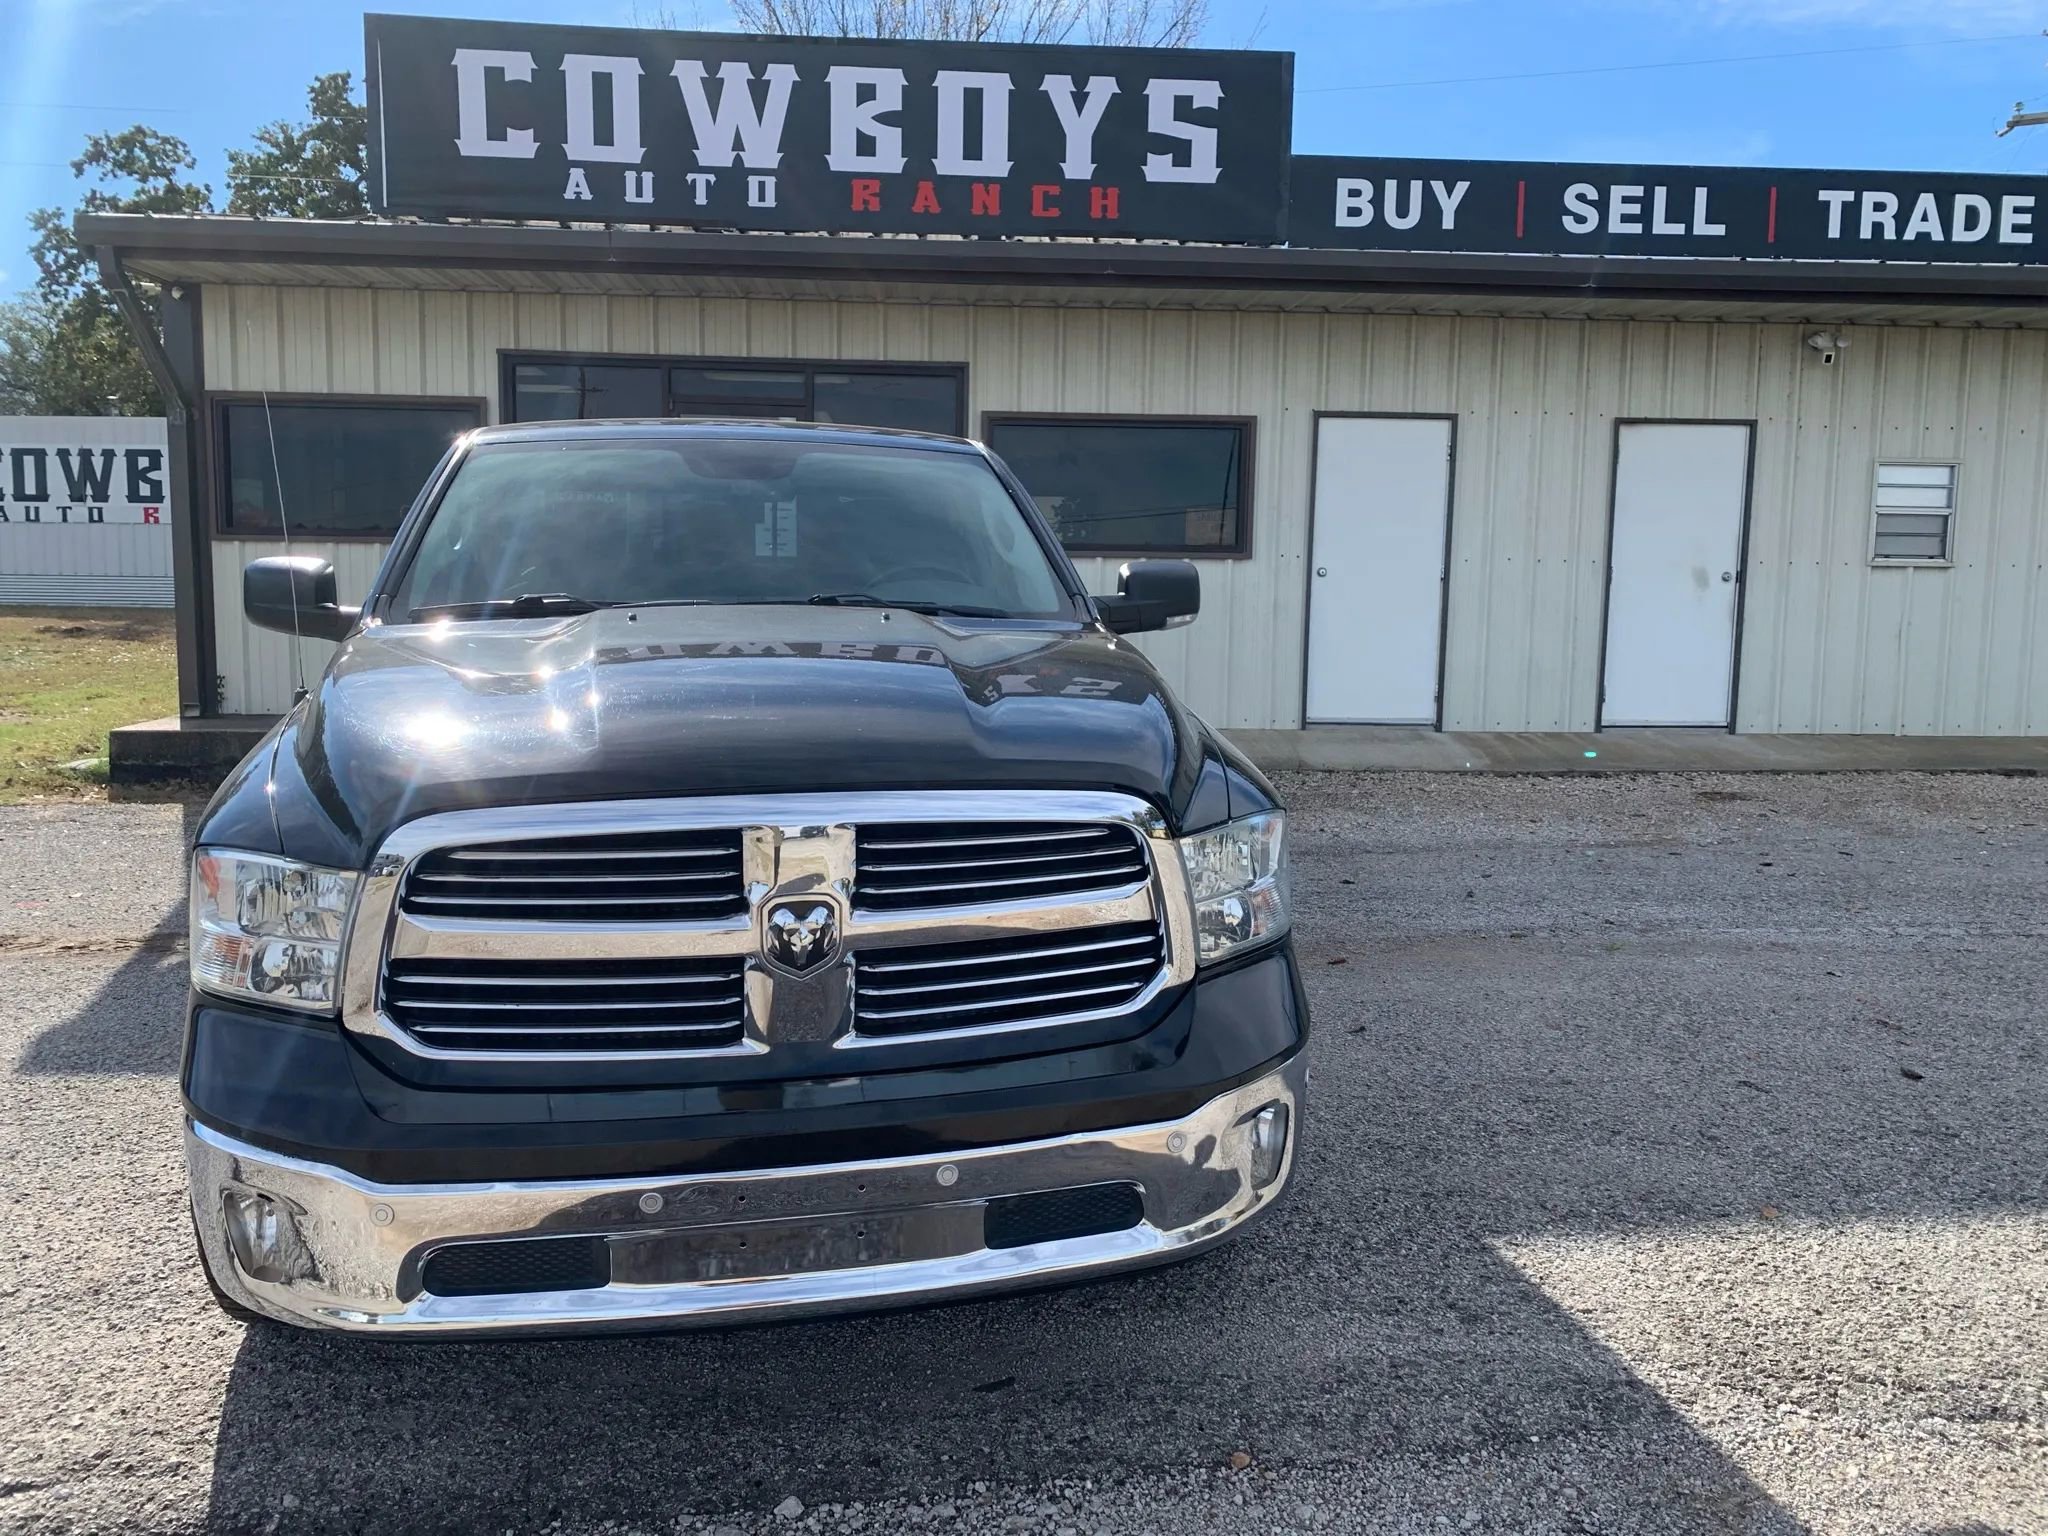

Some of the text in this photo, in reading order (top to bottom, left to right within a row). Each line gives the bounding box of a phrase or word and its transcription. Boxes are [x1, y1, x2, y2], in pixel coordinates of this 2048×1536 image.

[450, 48, 1225, 184] COWBOYS
[562, 168, 1121, 219] AUTO RANCH
[1335, 177, 2036, 244] BUY SELL TRADE
[0, 448, 165, 503] OWB
